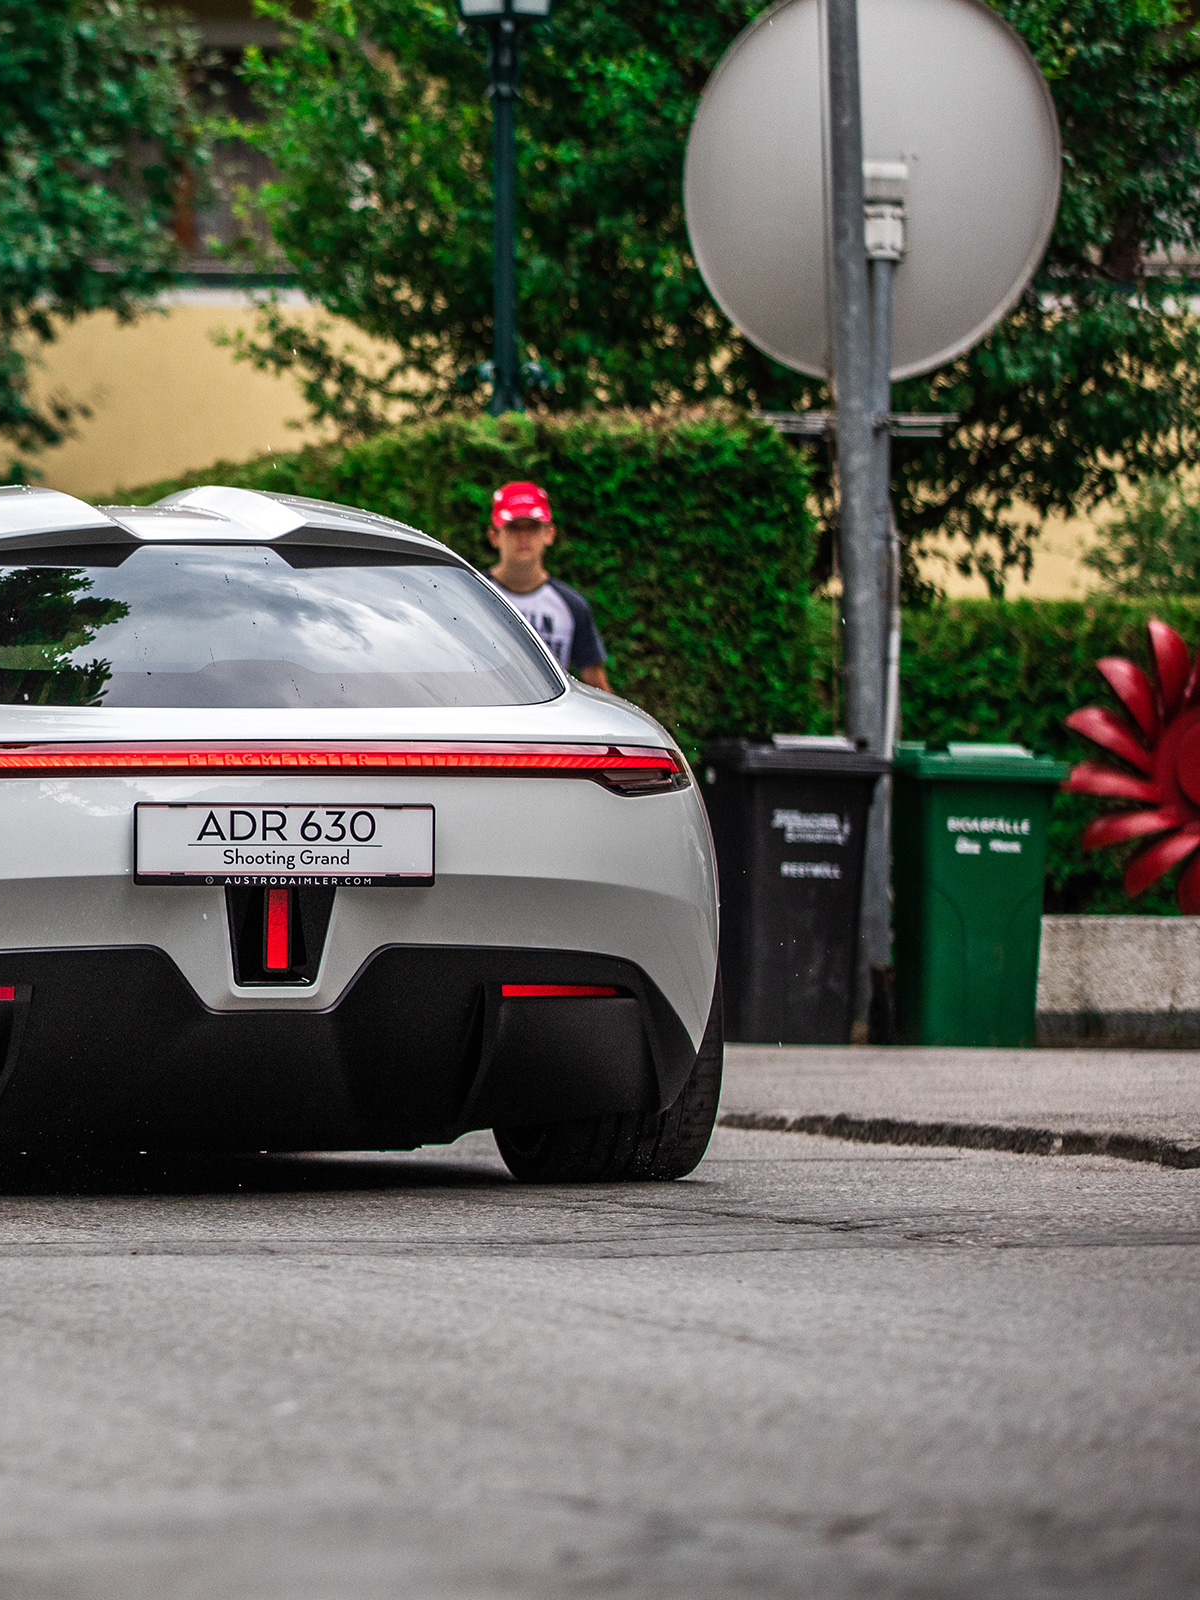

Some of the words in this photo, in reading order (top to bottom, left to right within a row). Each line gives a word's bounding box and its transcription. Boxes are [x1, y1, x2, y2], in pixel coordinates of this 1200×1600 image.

[189, 753, 369, 766] BERGMEISTER
[196, 810, 288, 841] ADR
[300, 810, 376, 842] 630
[223, 848, 295, 870] Shooting
[299, 849, 350, 866] Grand
[224, 876, 372, 886] AUSTRODAIMLER.COM
